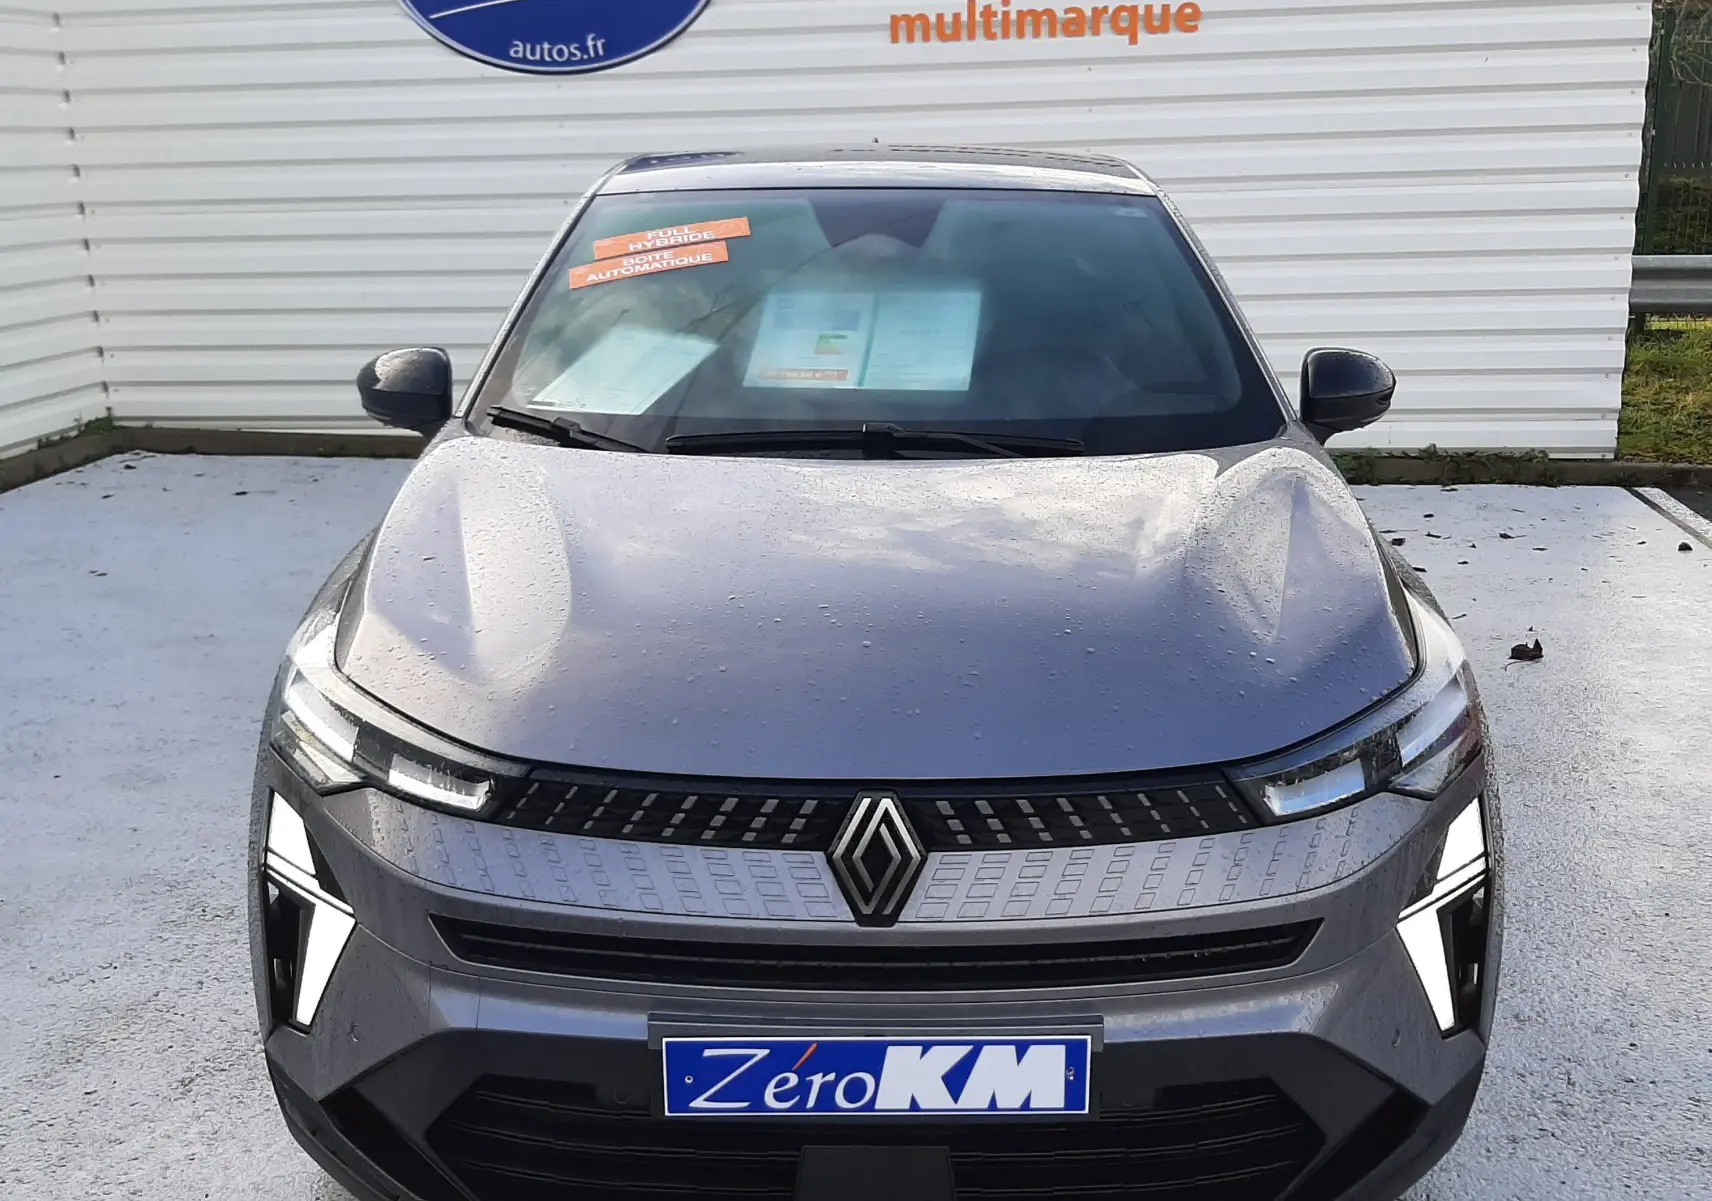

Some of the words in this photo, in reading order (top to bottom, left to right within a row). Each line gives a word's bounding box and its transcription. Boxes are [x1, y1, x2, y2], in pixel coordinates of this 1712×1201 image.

[889, 0, 1202, 45] multimarque
[509, 34, 606, 62] autos.fr
[628, 230, 716, 252] HYBRIDE
[647, 225, 694, 240] FULL
[586, 252, 713, 282] AUTOMATIQUE
